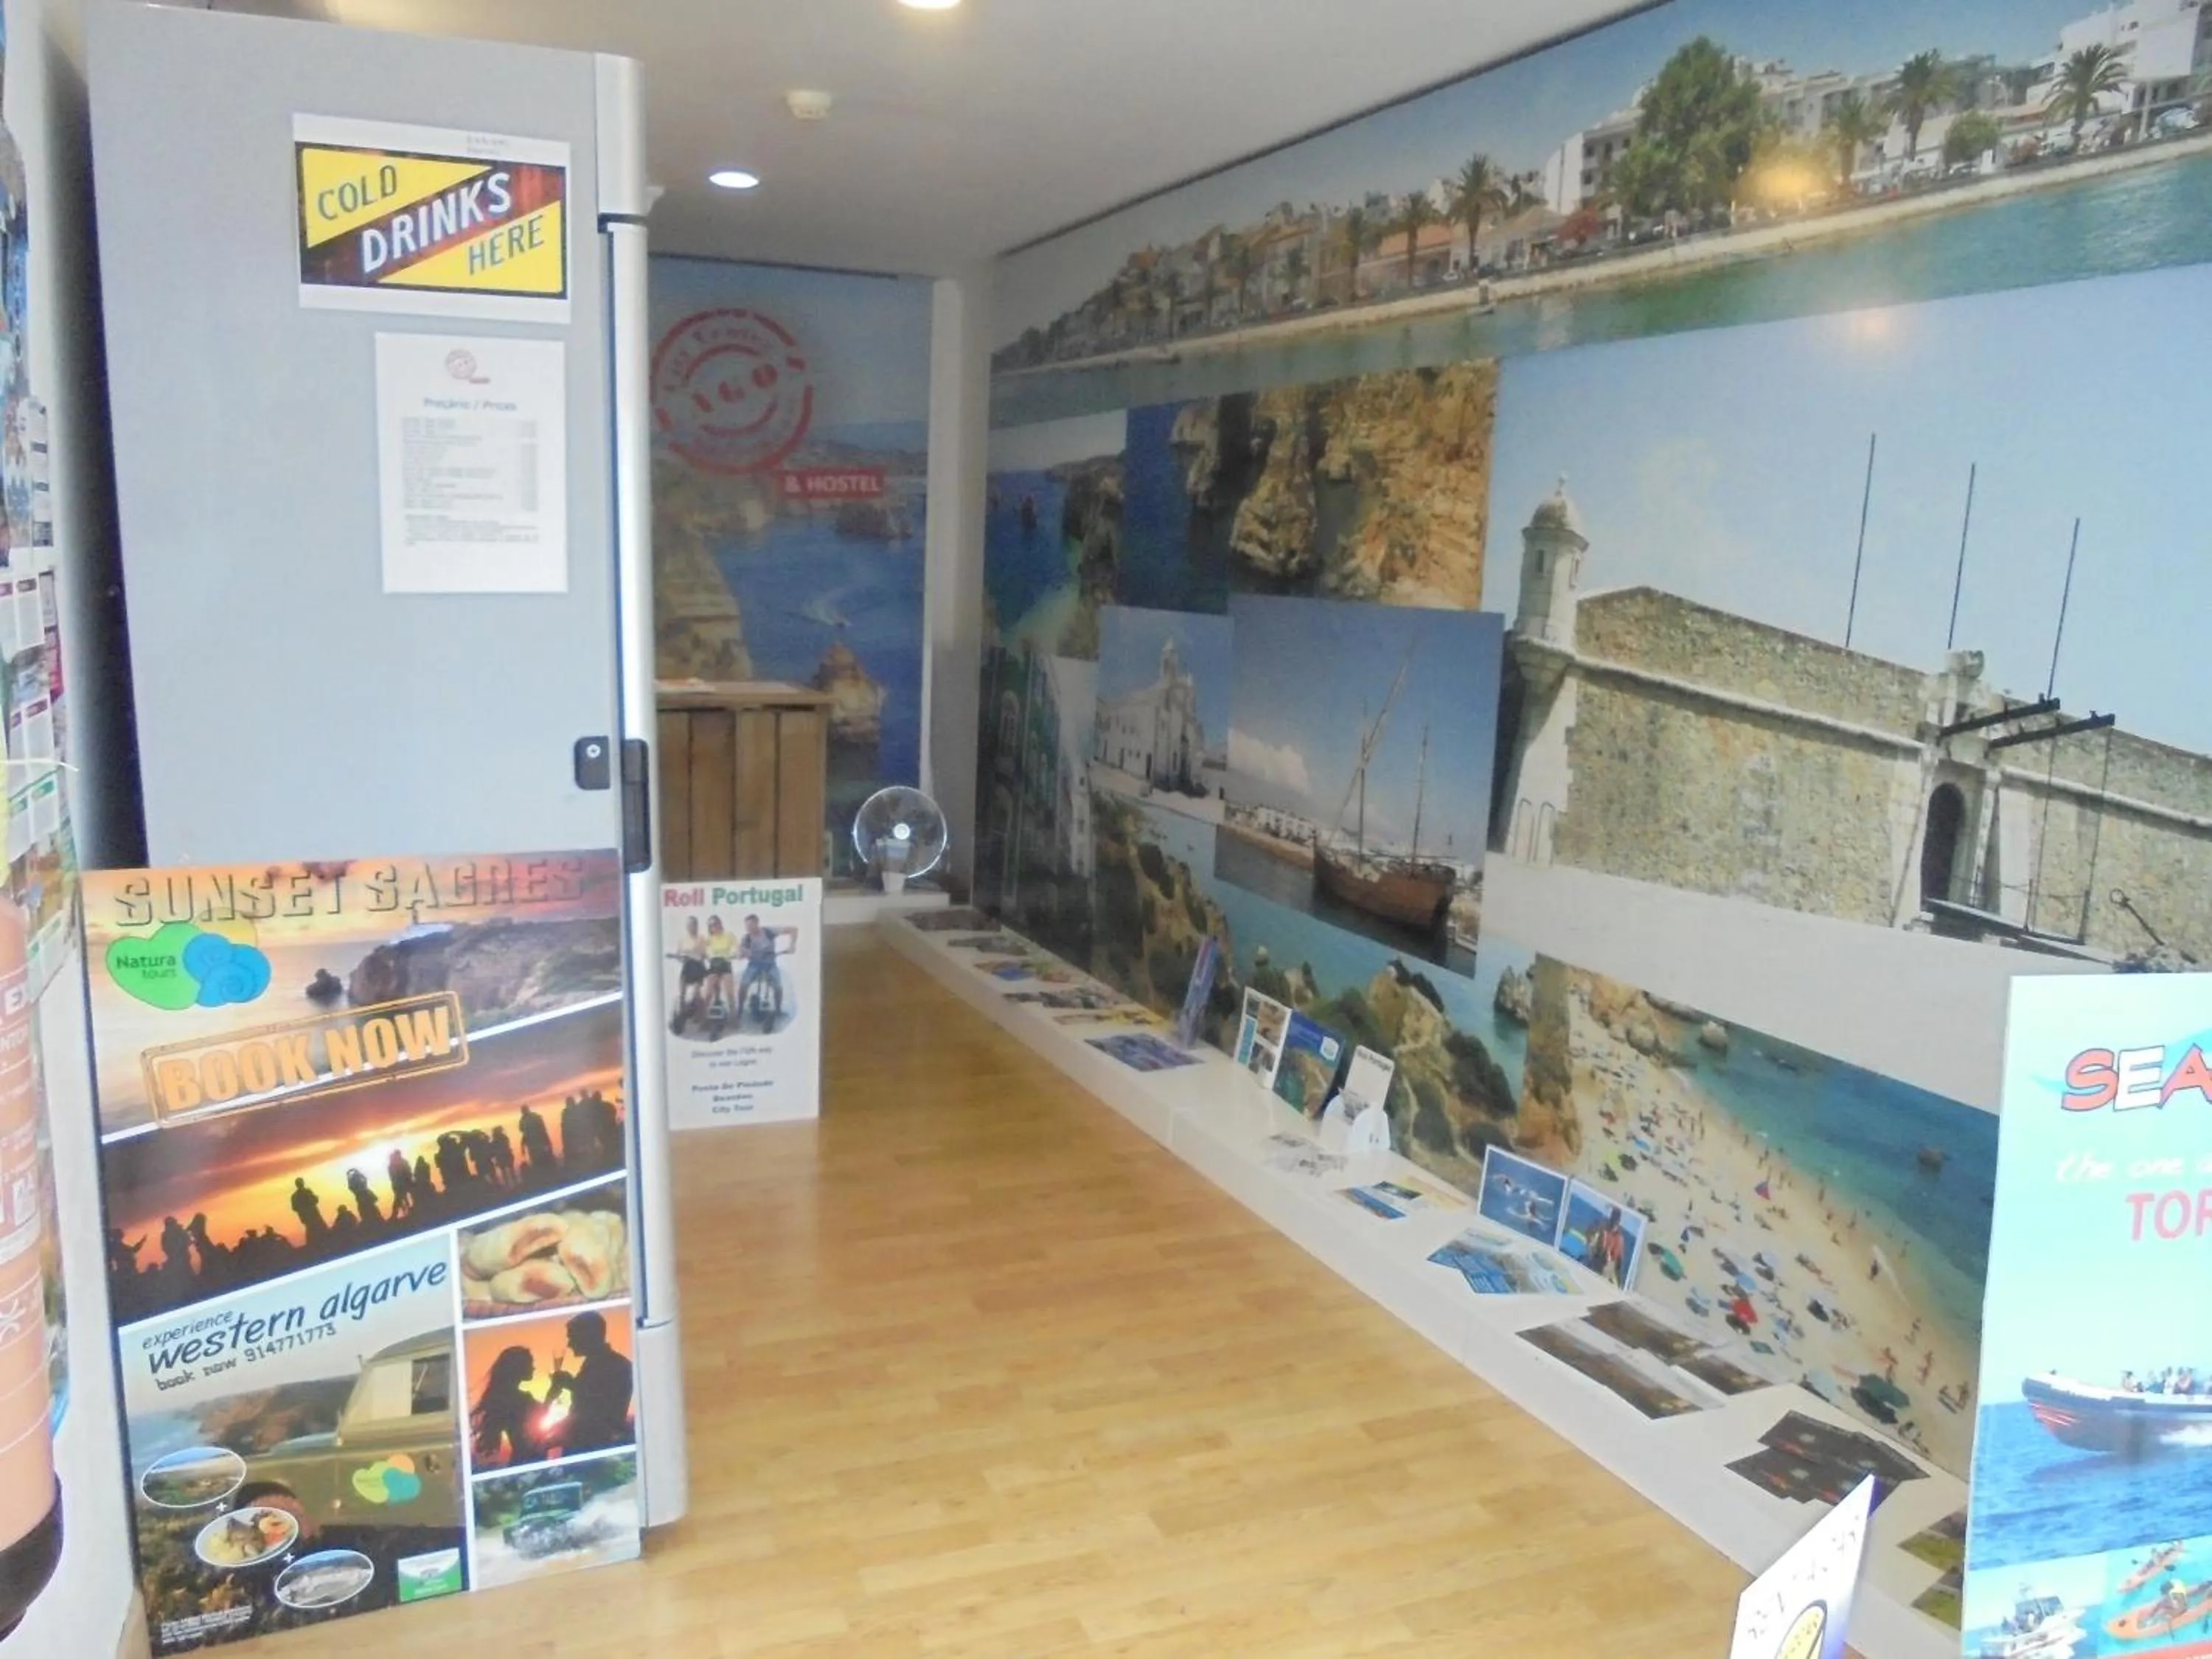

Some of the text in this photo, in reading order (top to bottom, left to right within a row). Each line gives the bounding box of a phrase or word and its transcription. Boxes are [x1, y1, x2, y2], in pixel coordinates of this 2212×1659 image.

[318, 164, 397, 221] COLD
[361, 171, 511, 275] DRINKS
[468, 215, 545, 276] HERE
[807, 475, 882, 492] HOSTEL
[113, 858, 584, 927] SUNSET SAGRES
[664, 884, 804, 908] Roll Portugal
[116, 954, 177, 970] Natura
[142, 967, 178, 980] tours
[157, 1005, 451, 1113] BOOK NOW
[2061, 1042, 2212, 1113] SEA
[142, 1308, 233, 1350] experience
[148, 1261, 447, 1376] western algarve
[156, 1322, 337, 1391] book now 914771773
